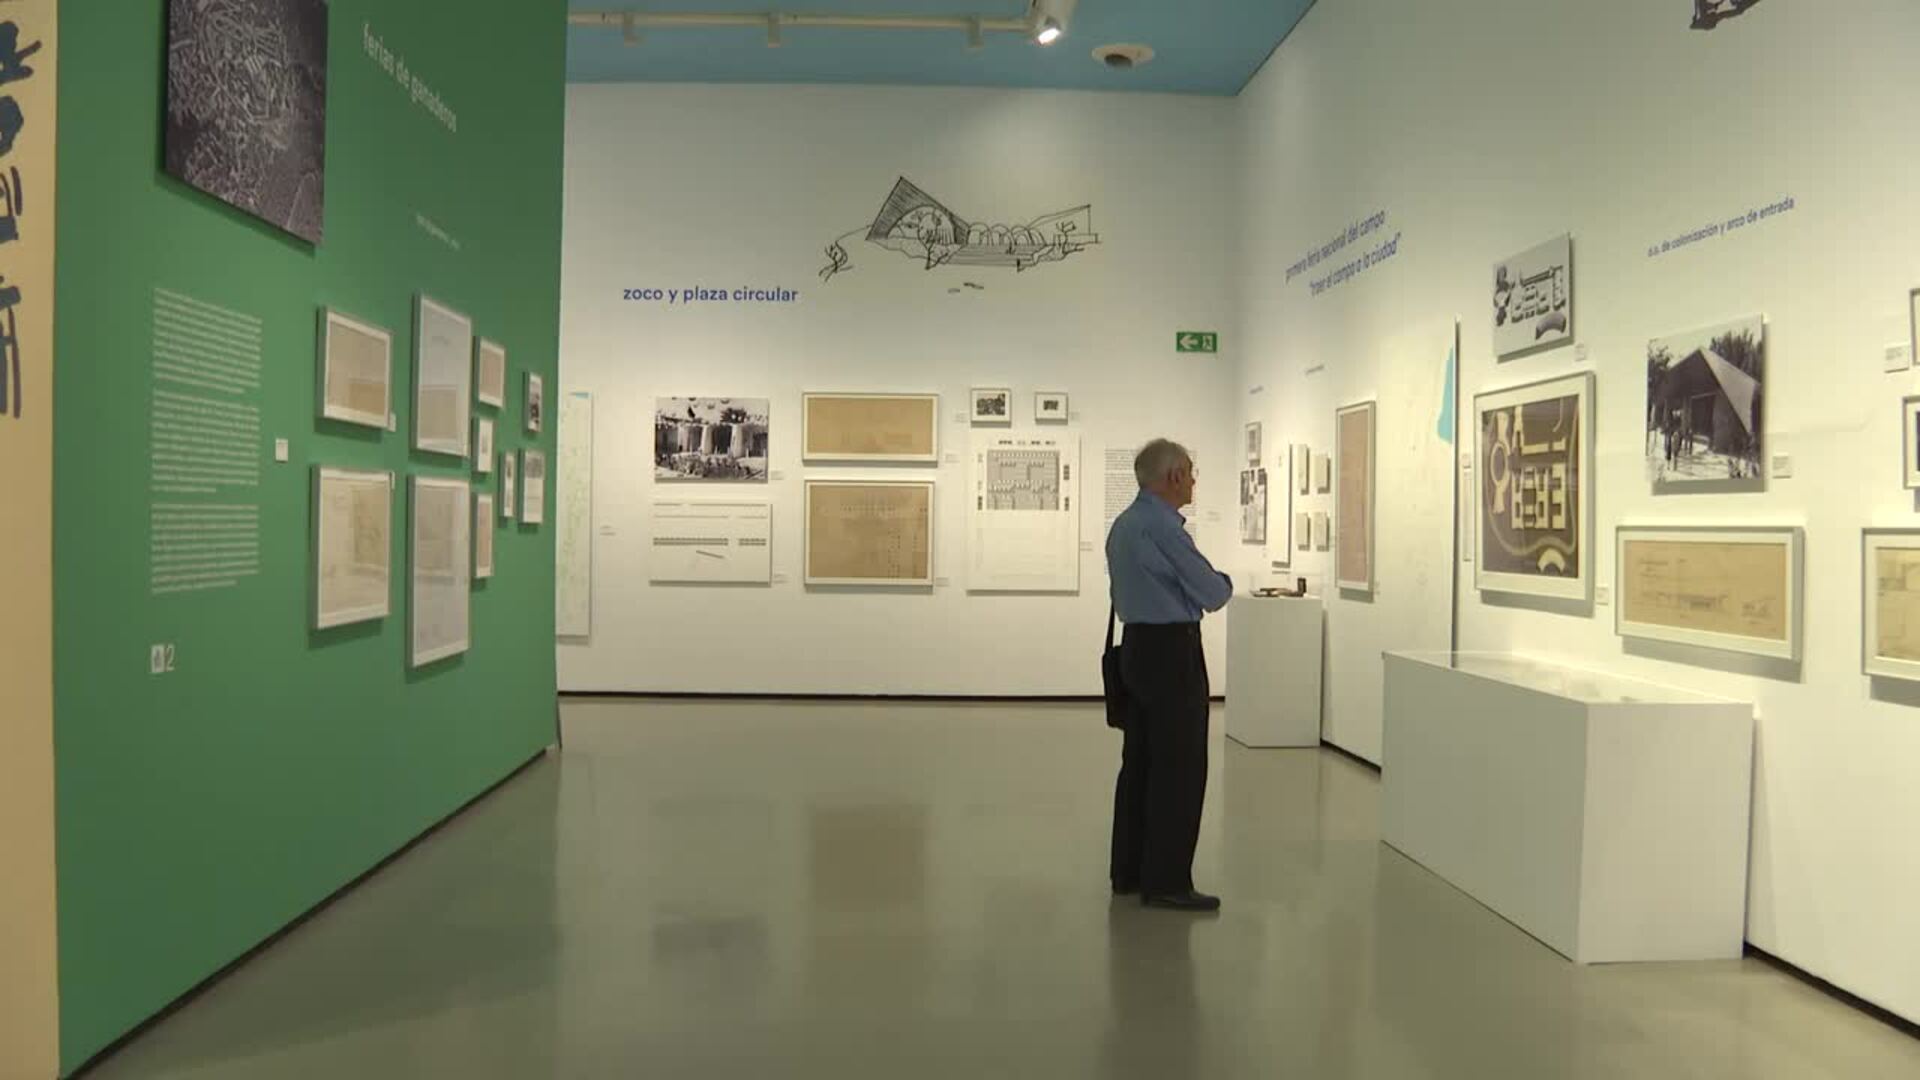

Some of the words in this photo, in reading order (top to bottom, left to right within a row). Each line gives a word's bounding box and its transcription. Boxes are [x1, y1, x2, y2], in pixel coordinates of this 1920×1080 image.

[1747, 208, 1758, 224] de
[1759, 197, 1795, 219] entrada
[623, 288, 664, 301] zoco
[668, 288, 678, 304] y
[683, 285, 728, 304] plaza
[732, 285, 798, 302] circular
